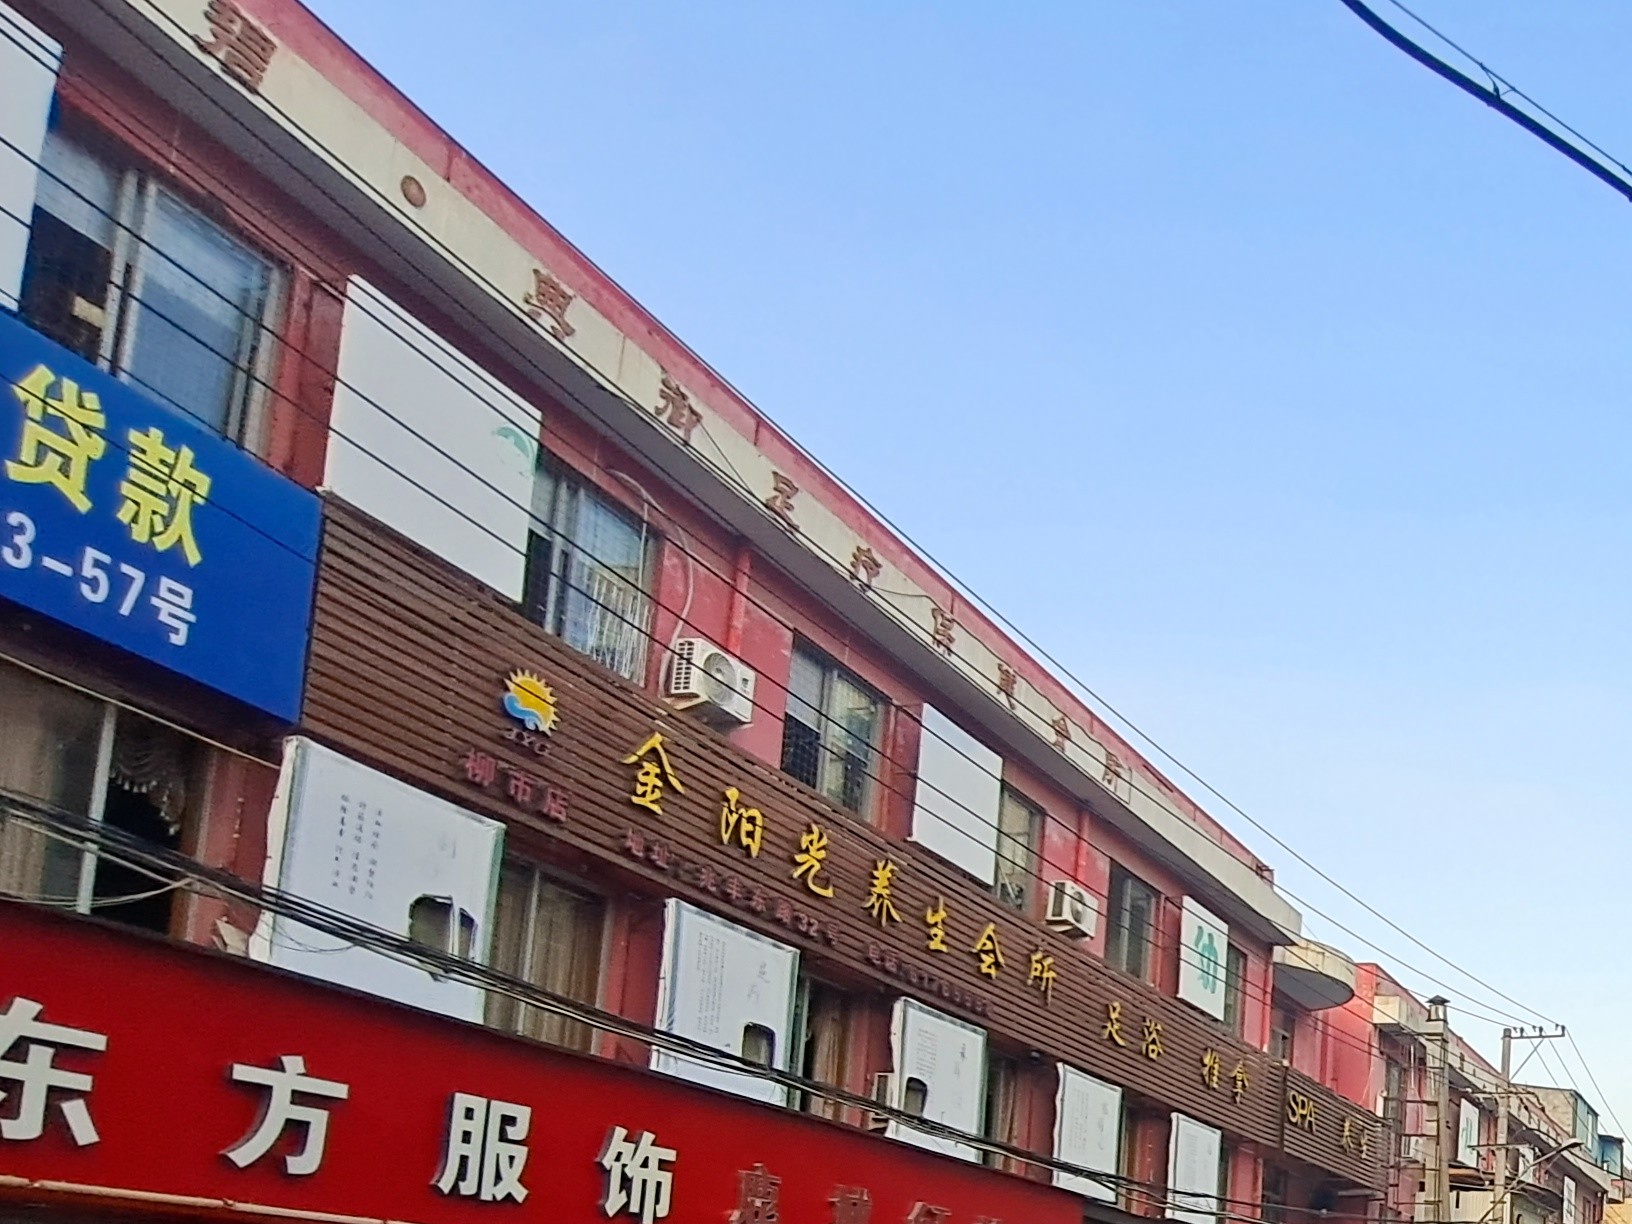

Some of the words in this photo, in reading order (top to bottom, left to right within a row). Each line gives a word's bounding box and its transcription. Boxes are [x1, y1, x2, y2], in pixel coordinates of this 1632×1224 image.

[5, 363, 213, 567] 贷款
[465, 749, 570, 823] 柳市店
[620, 731, 1057, 1007] 金阳光养生会所
[1102, 1001, 1164, 1062] 足浴
[1202, 1048, 1250, 1105] 推拿
[1287, 1091, 1317, 1133] SPA
